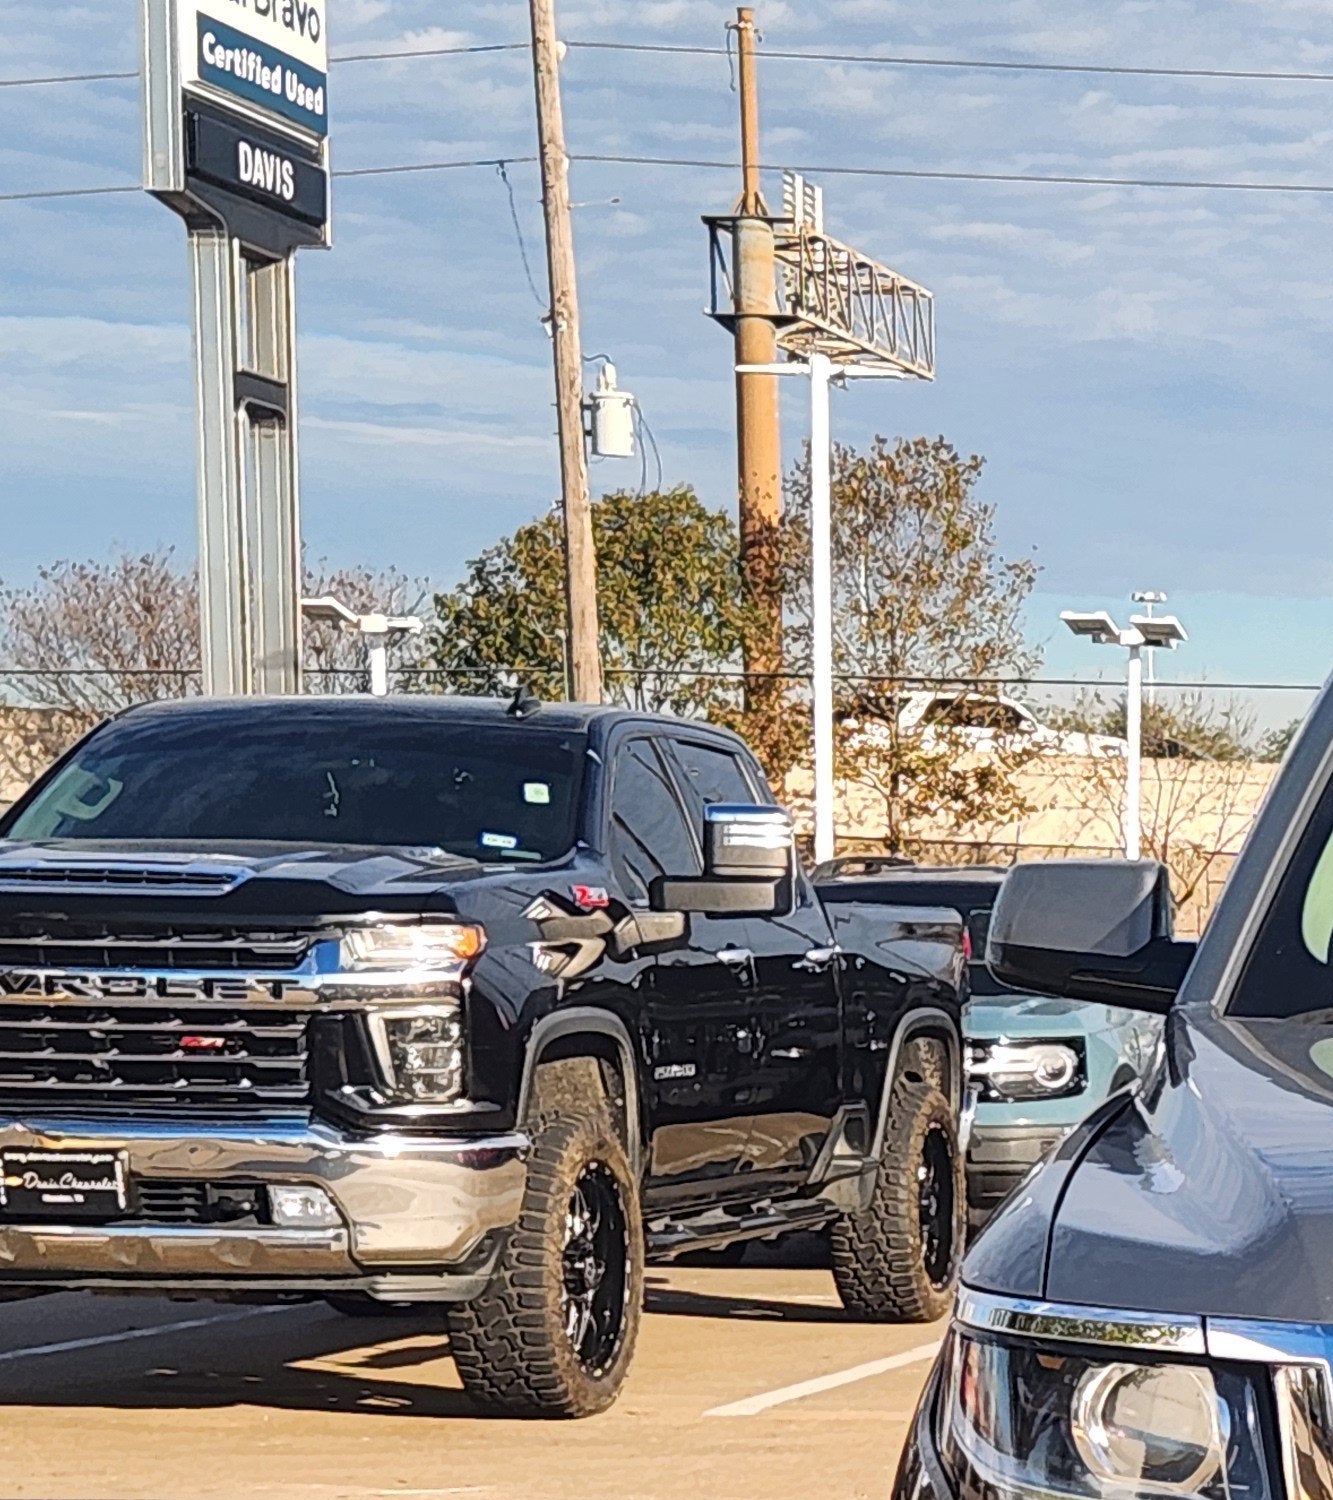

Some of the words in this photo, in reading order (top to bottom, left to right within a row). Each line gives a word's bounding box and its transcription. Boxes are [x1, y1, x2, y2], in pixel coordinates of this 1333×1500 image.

[202, 32, 282, 95] Certified
[285, 69, 324, 116] Used
[238, 140, 295, 200] DAVIS
